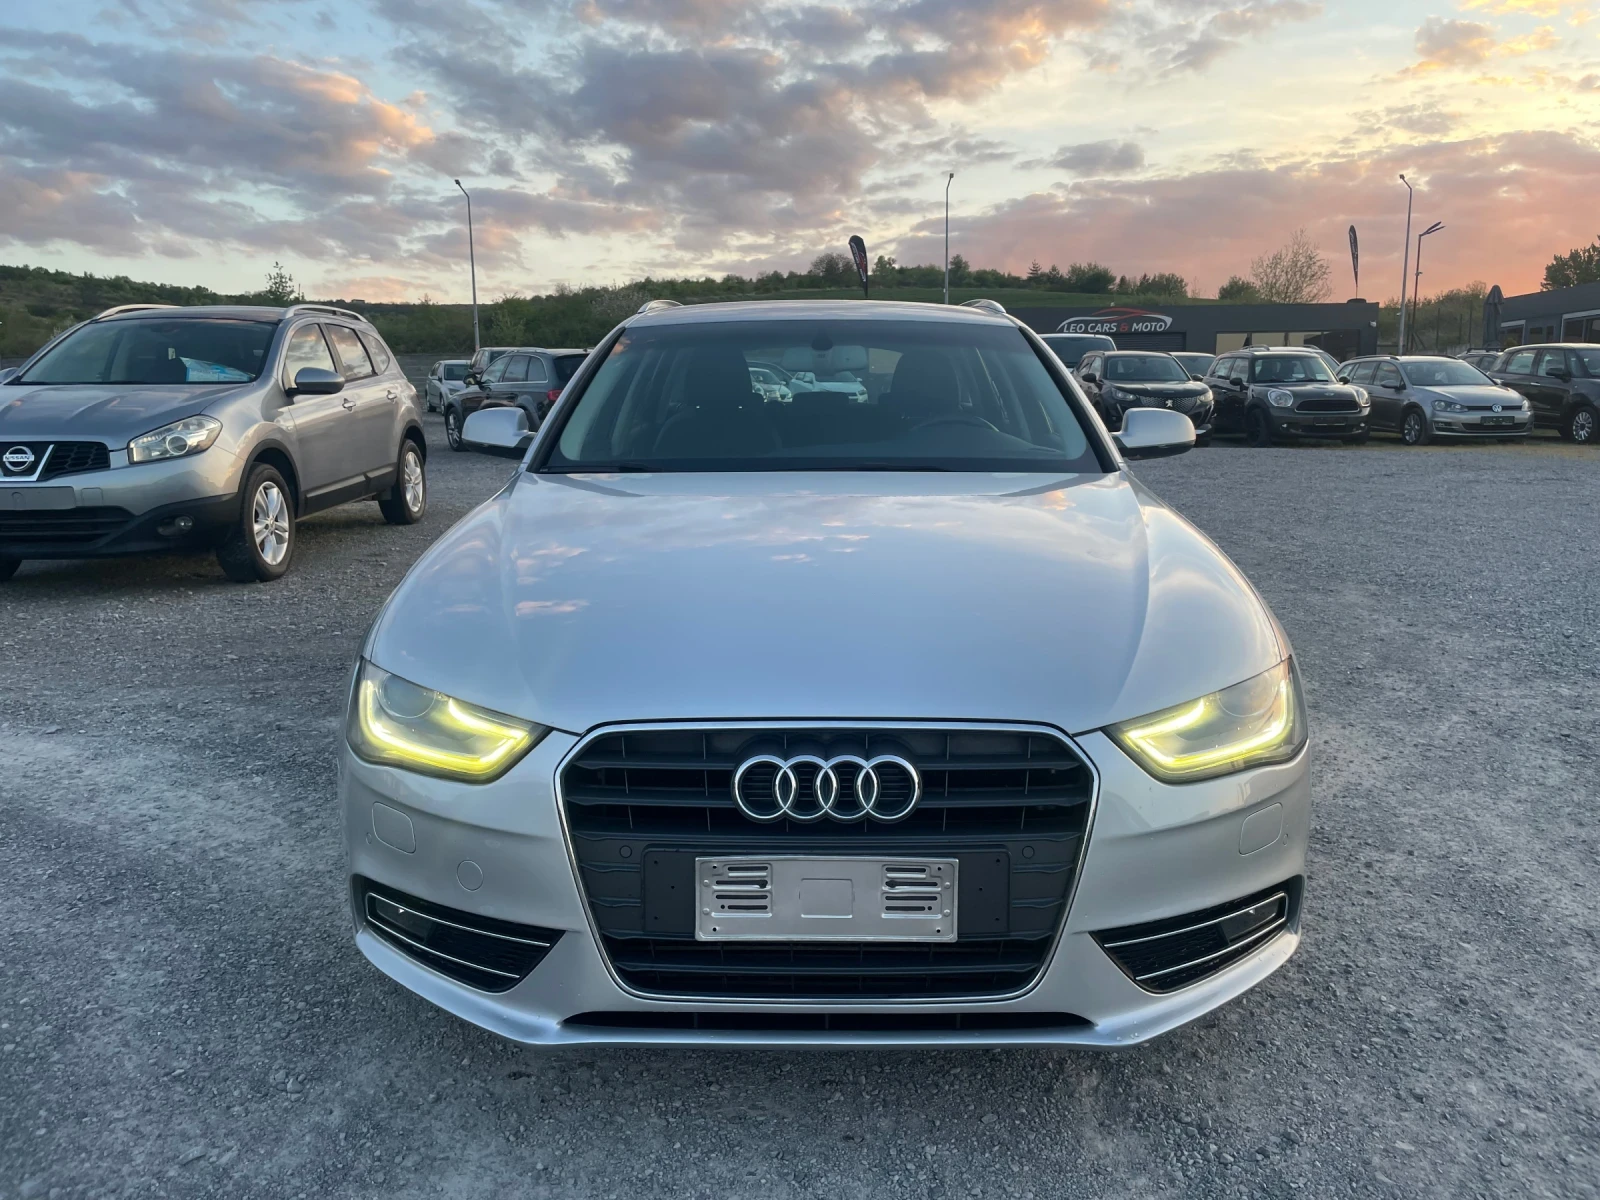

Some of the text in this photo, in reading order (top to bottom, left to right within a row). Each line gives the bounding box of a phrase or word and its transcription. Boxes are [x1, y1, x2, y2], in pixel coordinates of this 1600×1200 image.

[1063, 322, 1165, 333] LEO CARS & MOTO
